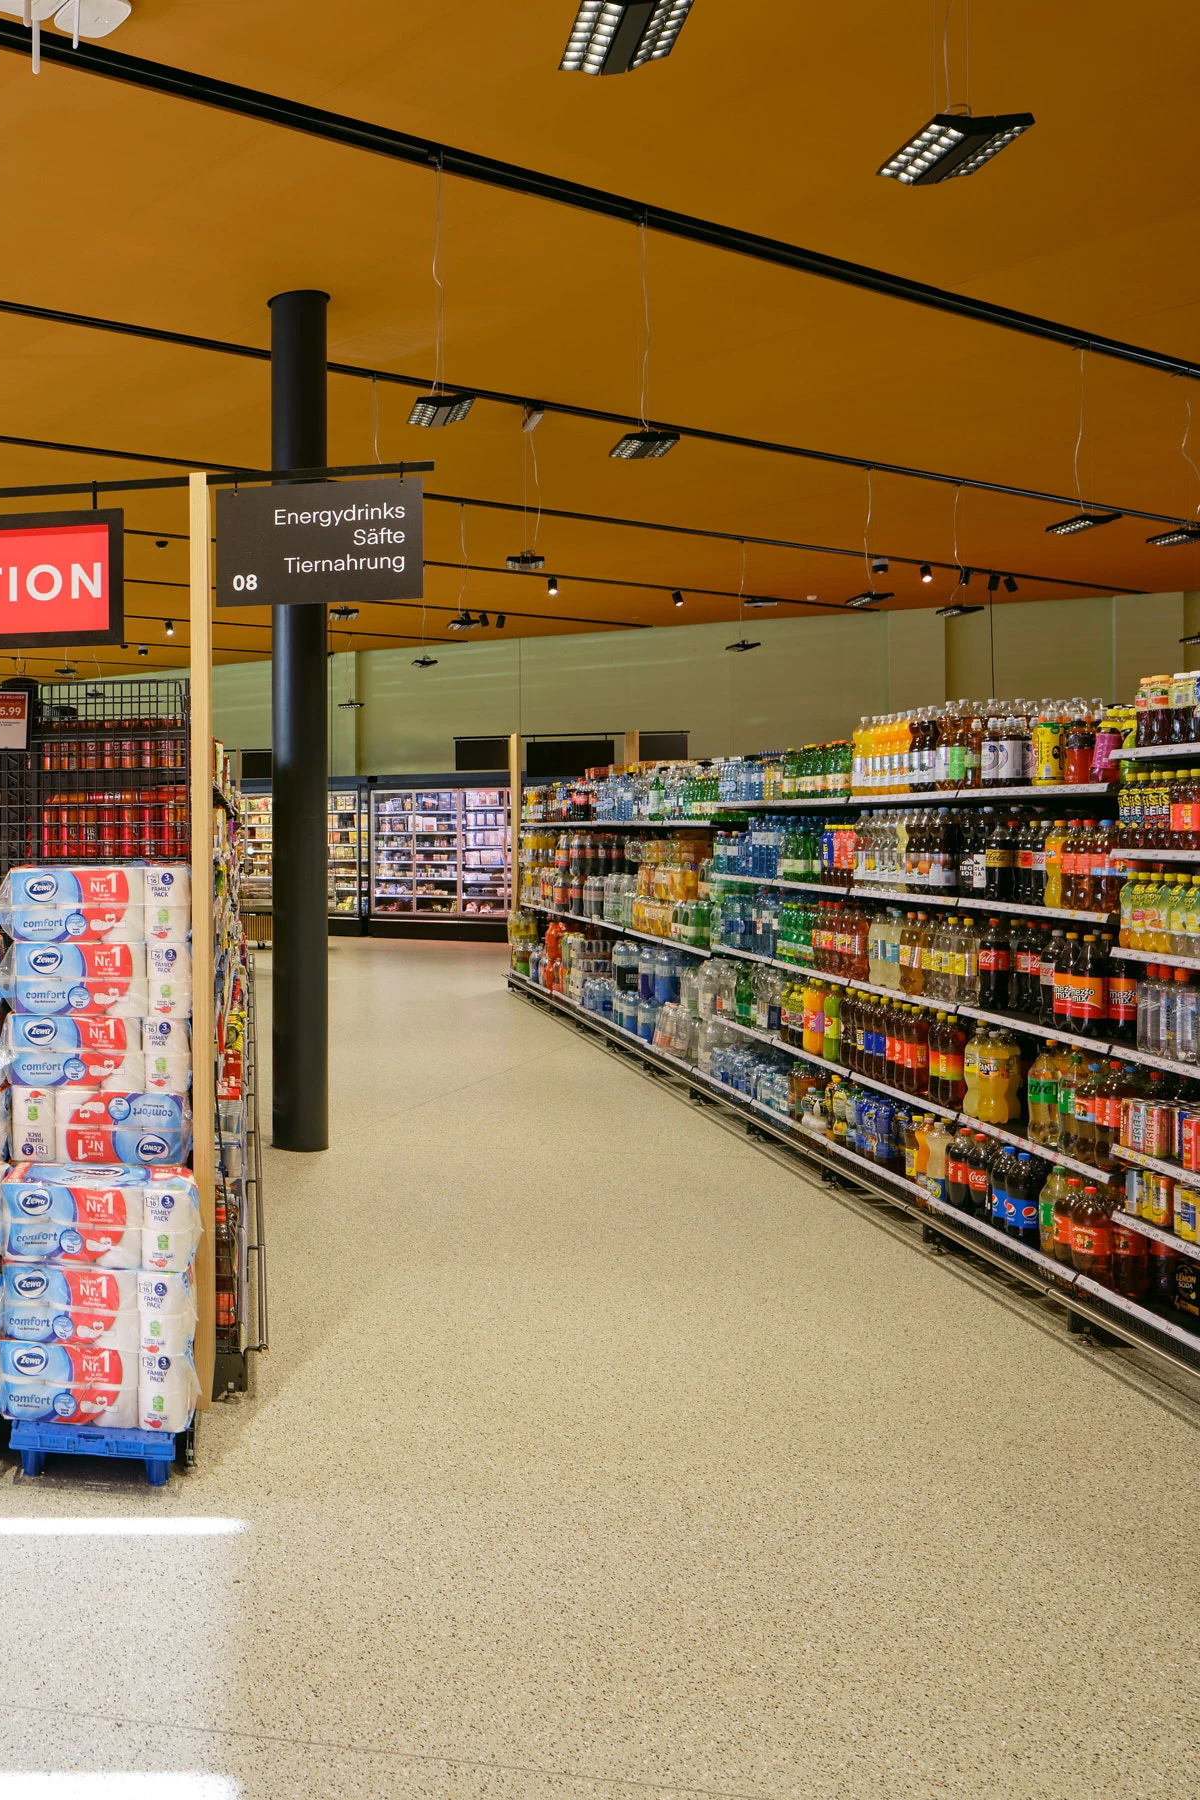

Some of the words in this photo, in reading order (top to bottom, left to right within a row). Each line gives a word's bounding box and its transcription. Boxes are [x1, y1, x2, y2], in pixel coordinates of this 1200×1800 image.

[274, 502, 405, 527] Energydrinks
[353, 527, 405, 546] Säfte
[283, 554, 405, 574] Tiernahrung
[232, 574, 258, 591] 08
[0, 707, 21, 716] 5.99
[31, 883, 54, 892] Zewa
[23, 919, 63, 928] comfort
[37, 955, 59, 964] Zewa
[26, 991, 66, 1000] comfort
[1072, 994, 1087, 1002] mix
[1109, 990, 1137, 998] mezzo
[1112, 997, 1131, 1005] mix
[31, 1027, 52, 1035] Zewa
[21, 1062, 61, 1071] comfort
[979, 1063, 997, 1072] FANTA
[132, 1108, 173, 1116] comfort
[143, 1144, 162, 1153] Zewa
[25, 1195, 45, 1205] Zewa
[16, 1231, 58, 1242] comfort
[21, 1279, 41, 1288] Zewa
[9, 1317, 50, 1327] comfort
[20, 1355, 41, 1364] Zewa
[8, 1395, 51, 1405] comfort
